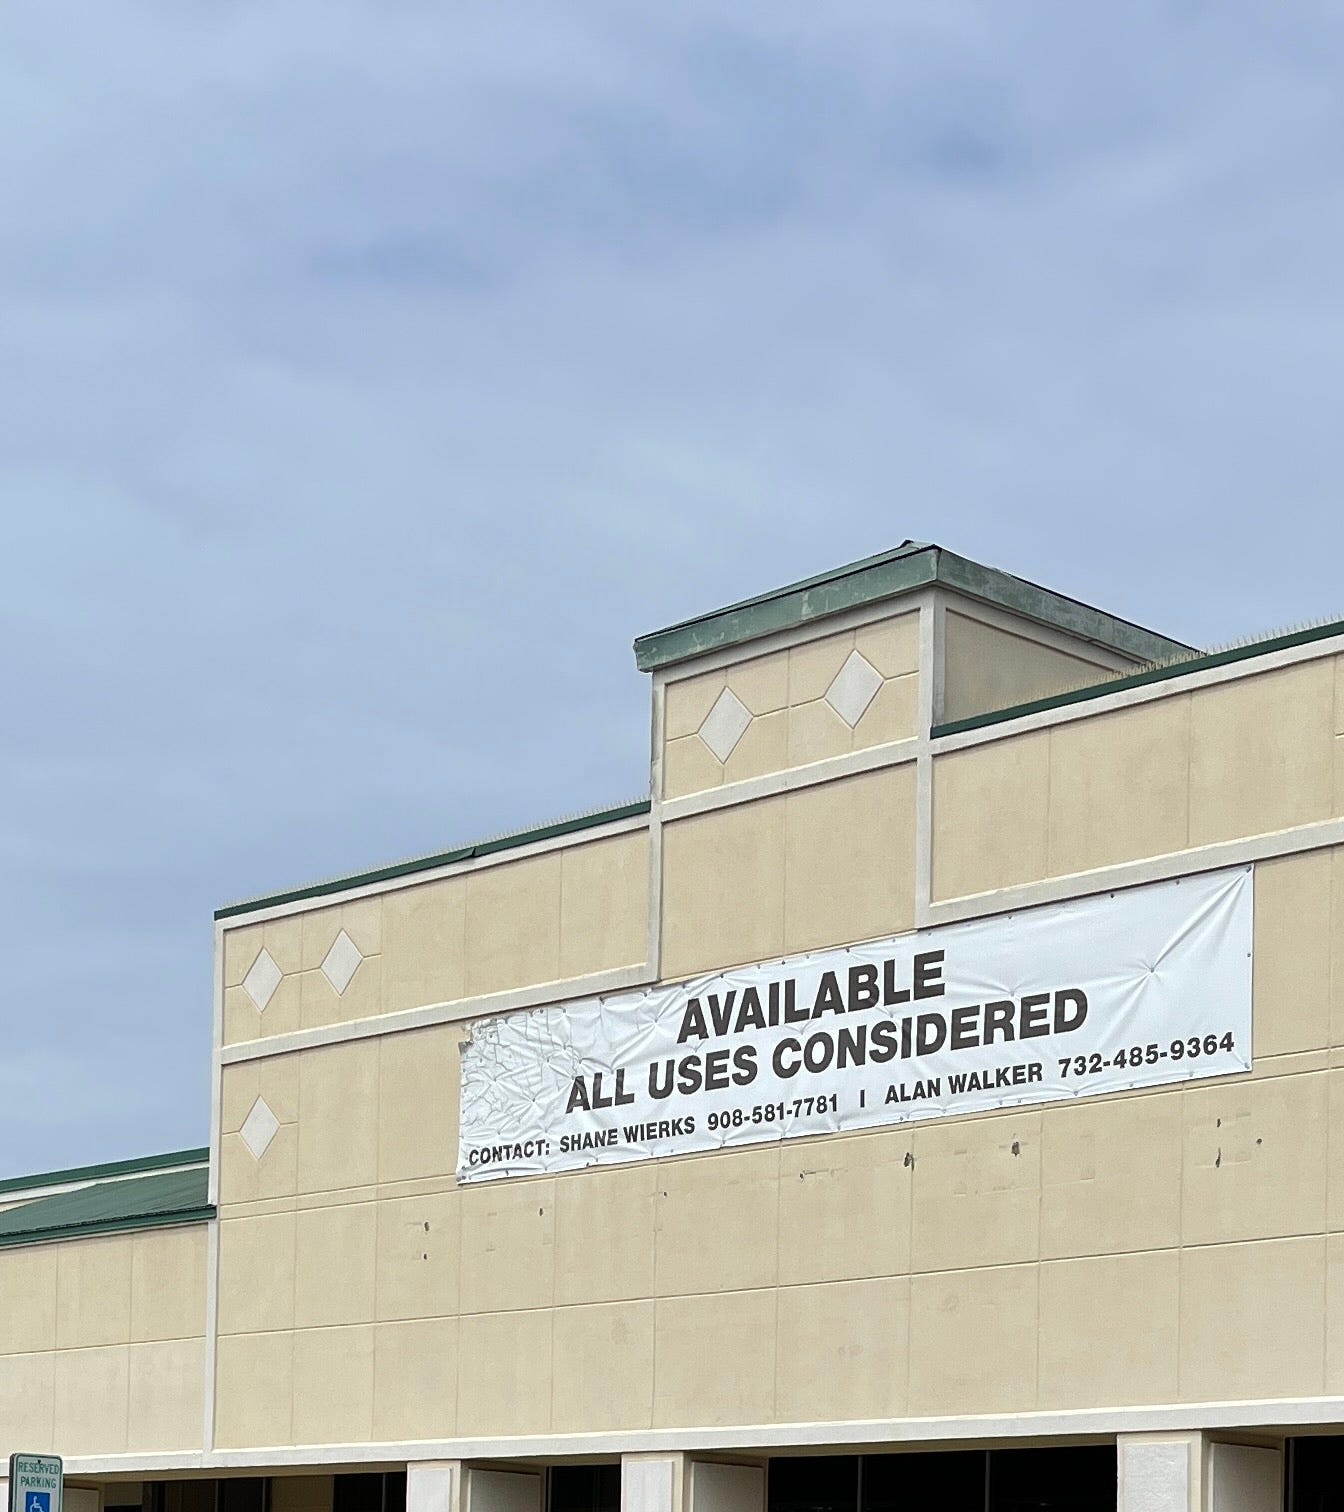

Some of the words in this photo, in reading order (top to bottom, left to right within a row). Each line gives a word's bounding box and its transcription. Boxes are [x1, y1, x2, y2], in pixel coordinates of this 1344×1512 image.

[676, 949, 947, 1043] AVAILABLE
[565, 1068, 635, 1114] ALL
[648, 1045, 758, 1100] USES
[770, 987, 1088, 1081] CONSIDERED
[468, 1139, 550, 1166] CONTACT:
[559, 1129, 618, 1153] SHANE
[624, 1116, 695, 1143] WIERKS
[707, 1093, 837, 1131] 908-581-7781
[884, 1077, 941, 1105] ALAN
[947, 1062, 1043, 1095] WALKER
[1058, 1031, 1235, 1078] 732-485-9364
[18, 1461, 59, 1475] RESERVED
[20, 1476, 57, 1489] PARKING
